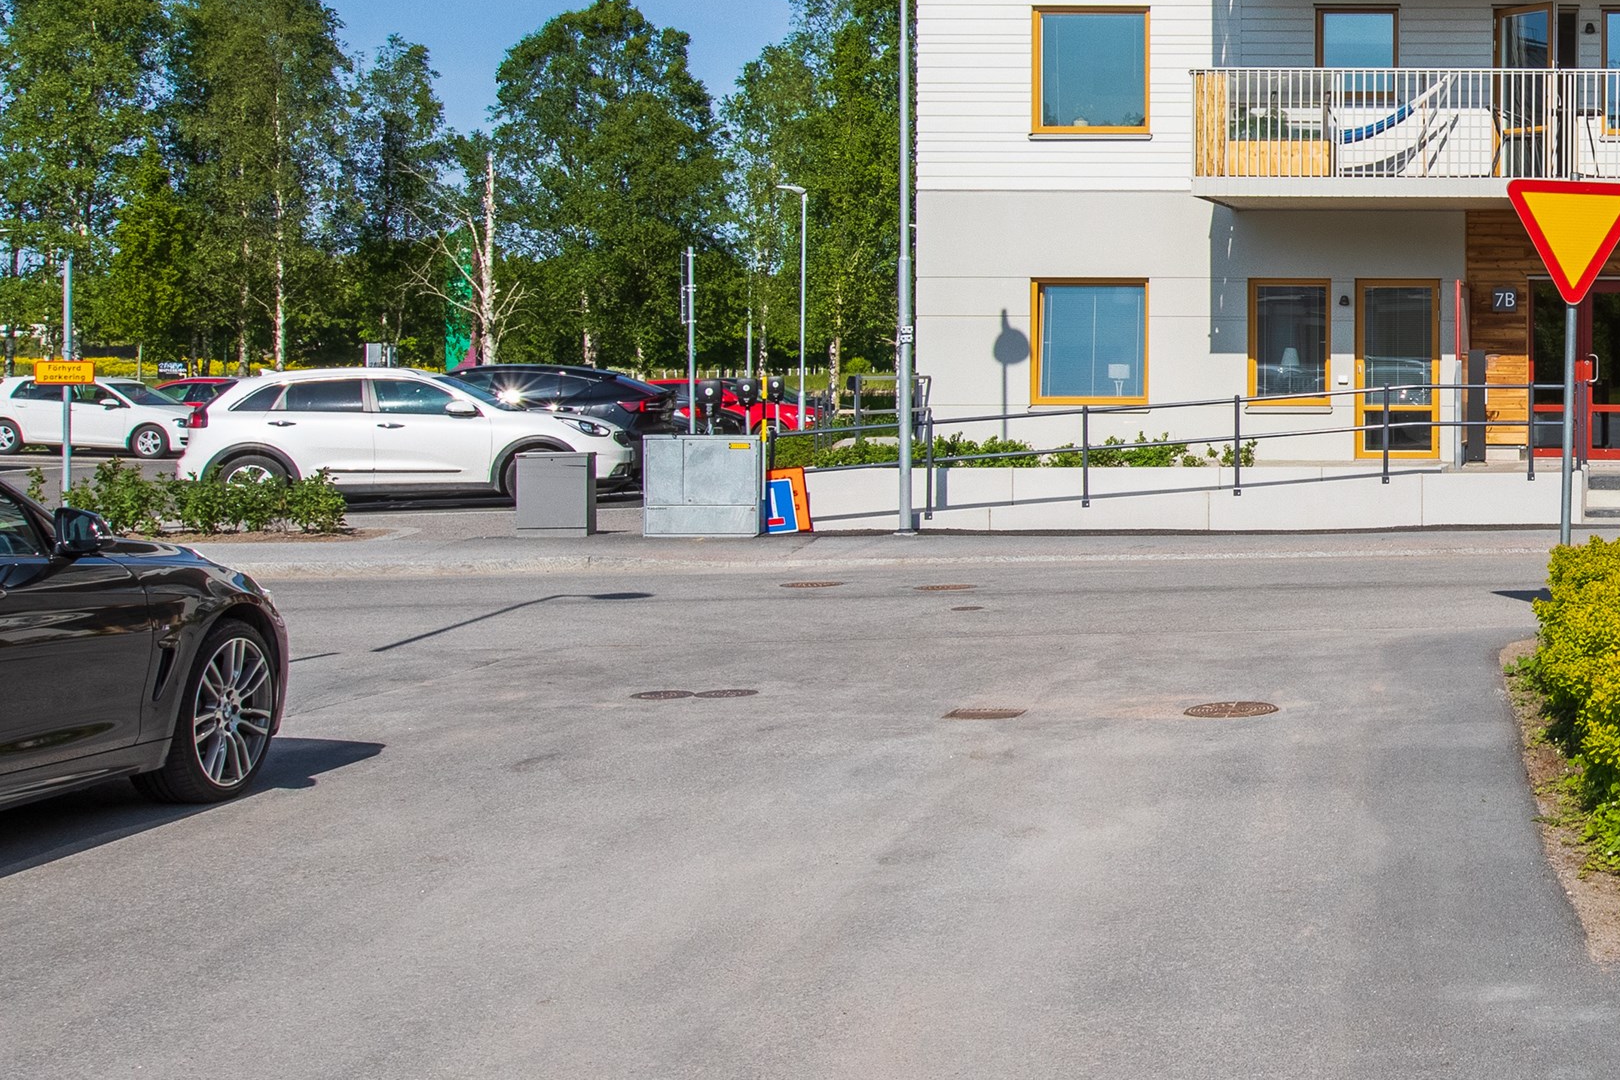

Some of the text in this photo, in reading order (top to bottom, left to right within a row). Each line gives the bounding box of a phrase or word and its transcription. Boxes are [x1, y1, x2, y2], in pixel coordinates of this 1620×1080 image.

[1494, 292, 1515, 307] 7B
[47, 364, 82, 372] Förhyrd
[43, 373, 86, 382] parkering
